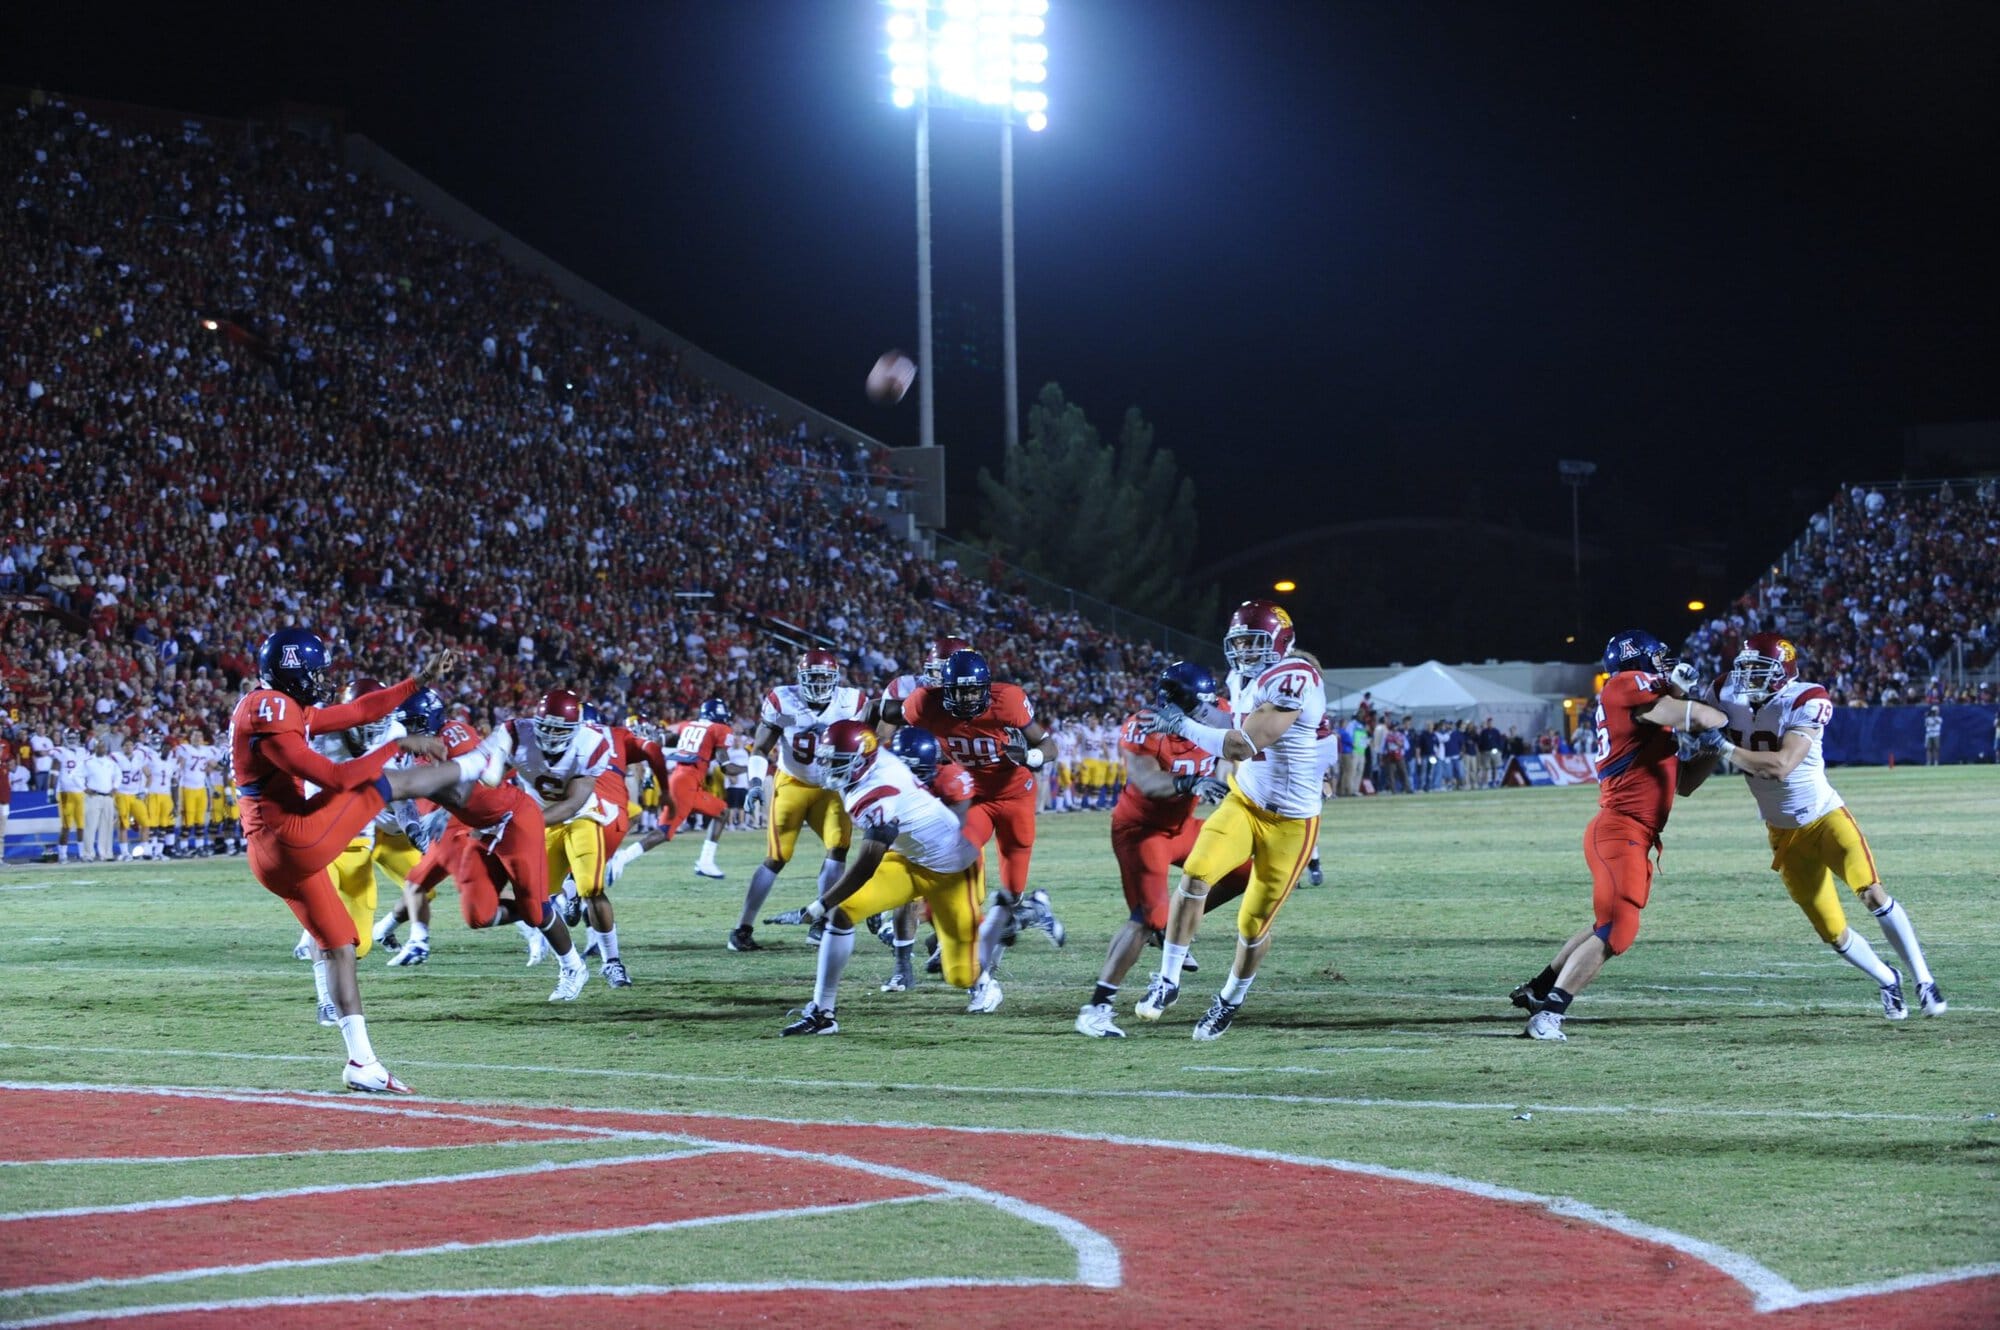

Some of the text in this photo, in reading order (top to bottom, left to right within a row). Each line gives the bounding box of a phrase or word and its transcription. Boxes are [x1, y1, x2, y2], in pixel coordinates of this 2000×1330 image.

[280, 645, 302, 668] A
[1278, 674, 1307, 698] 47
[258, 697, 286, 722] 47
[443, 725, 470, 747] 35
[676, 726, 707, 753] 89
[948, 736, 1000, 767] 29
